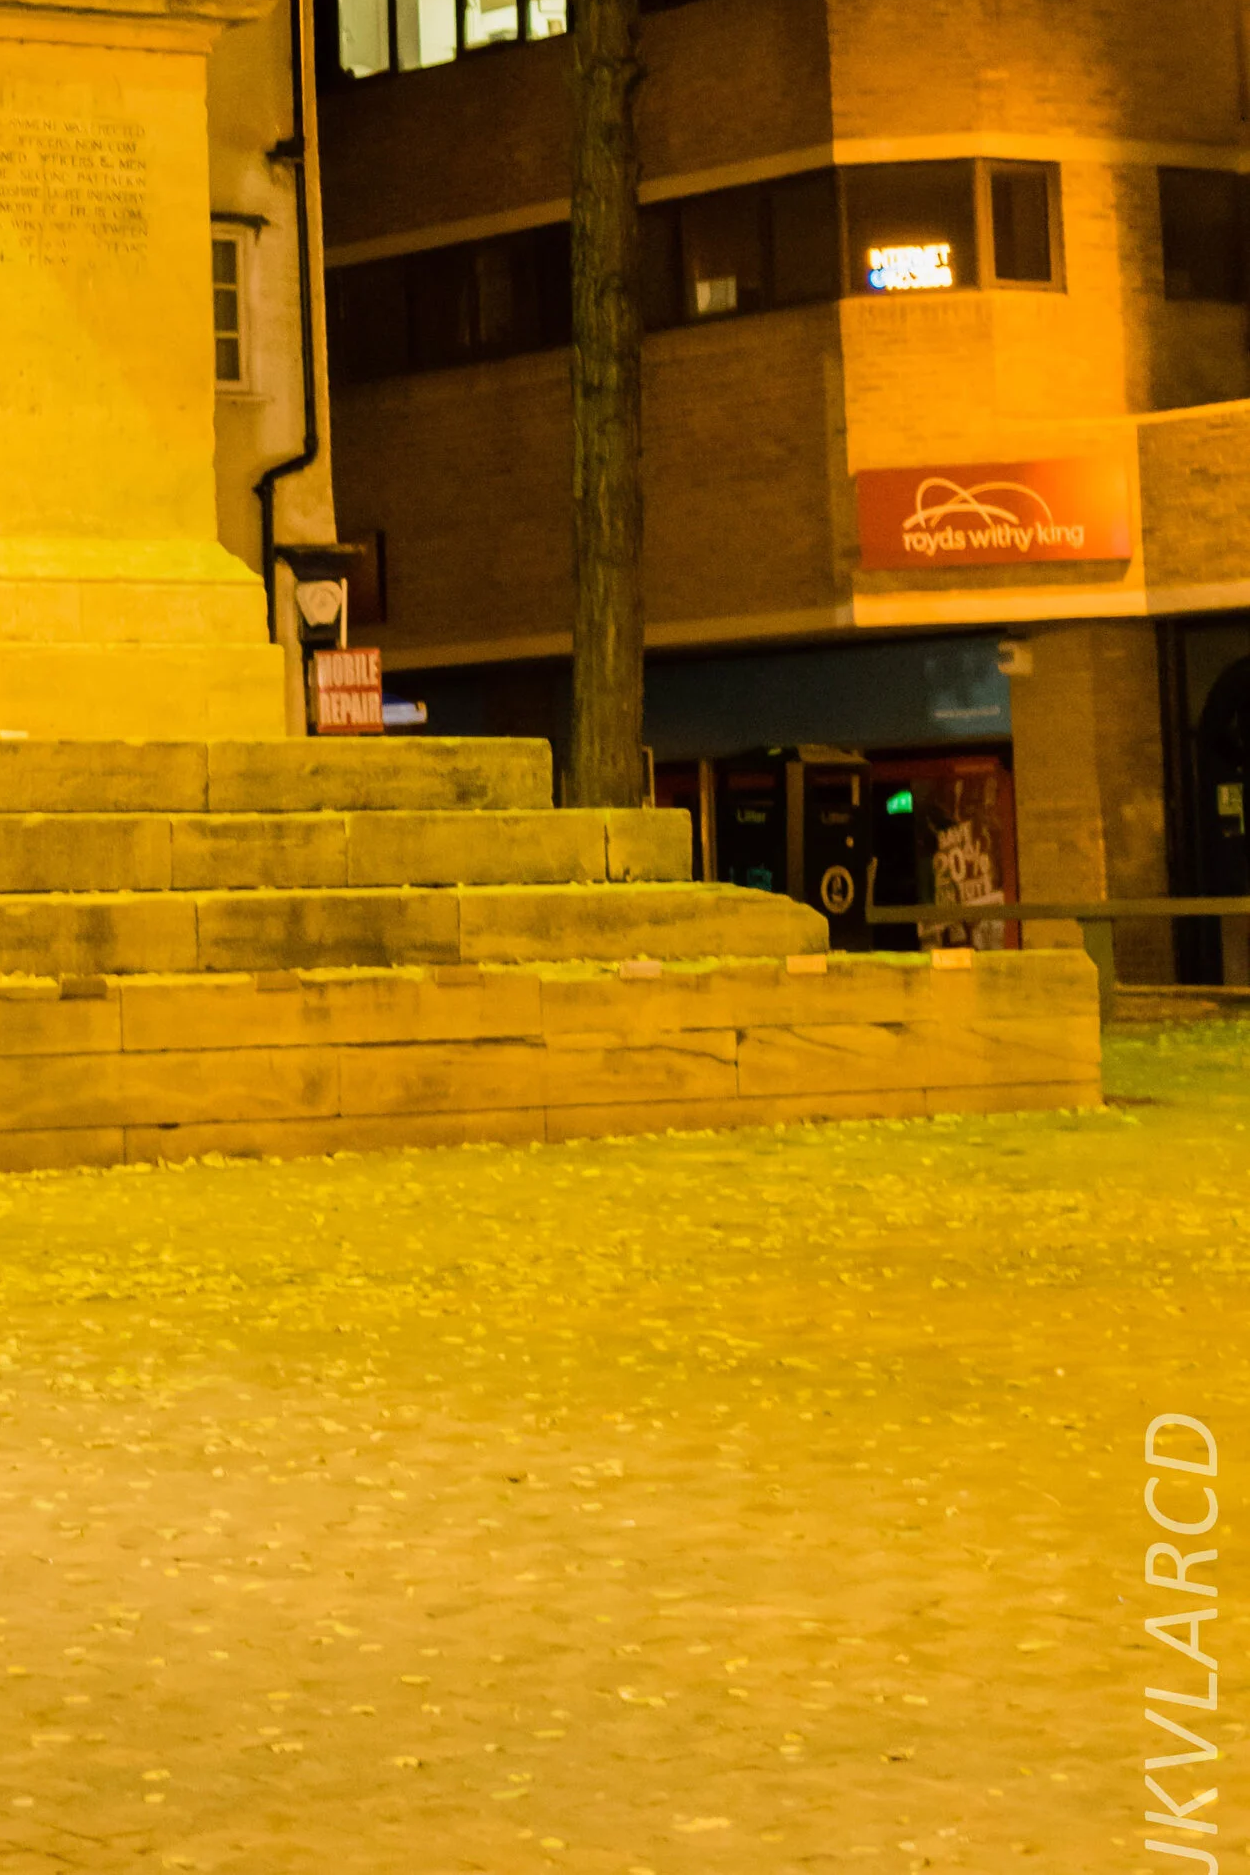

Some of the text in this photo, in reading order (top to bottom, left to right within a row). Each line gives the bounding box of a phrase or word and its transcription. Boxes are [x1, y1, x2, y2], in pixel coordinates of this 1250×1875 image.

[903, 521, 1085, 557] royds withy king
[318, 652, 381, 725] MOBILE REPAIR
[933, 839, 990, 882] 20%
